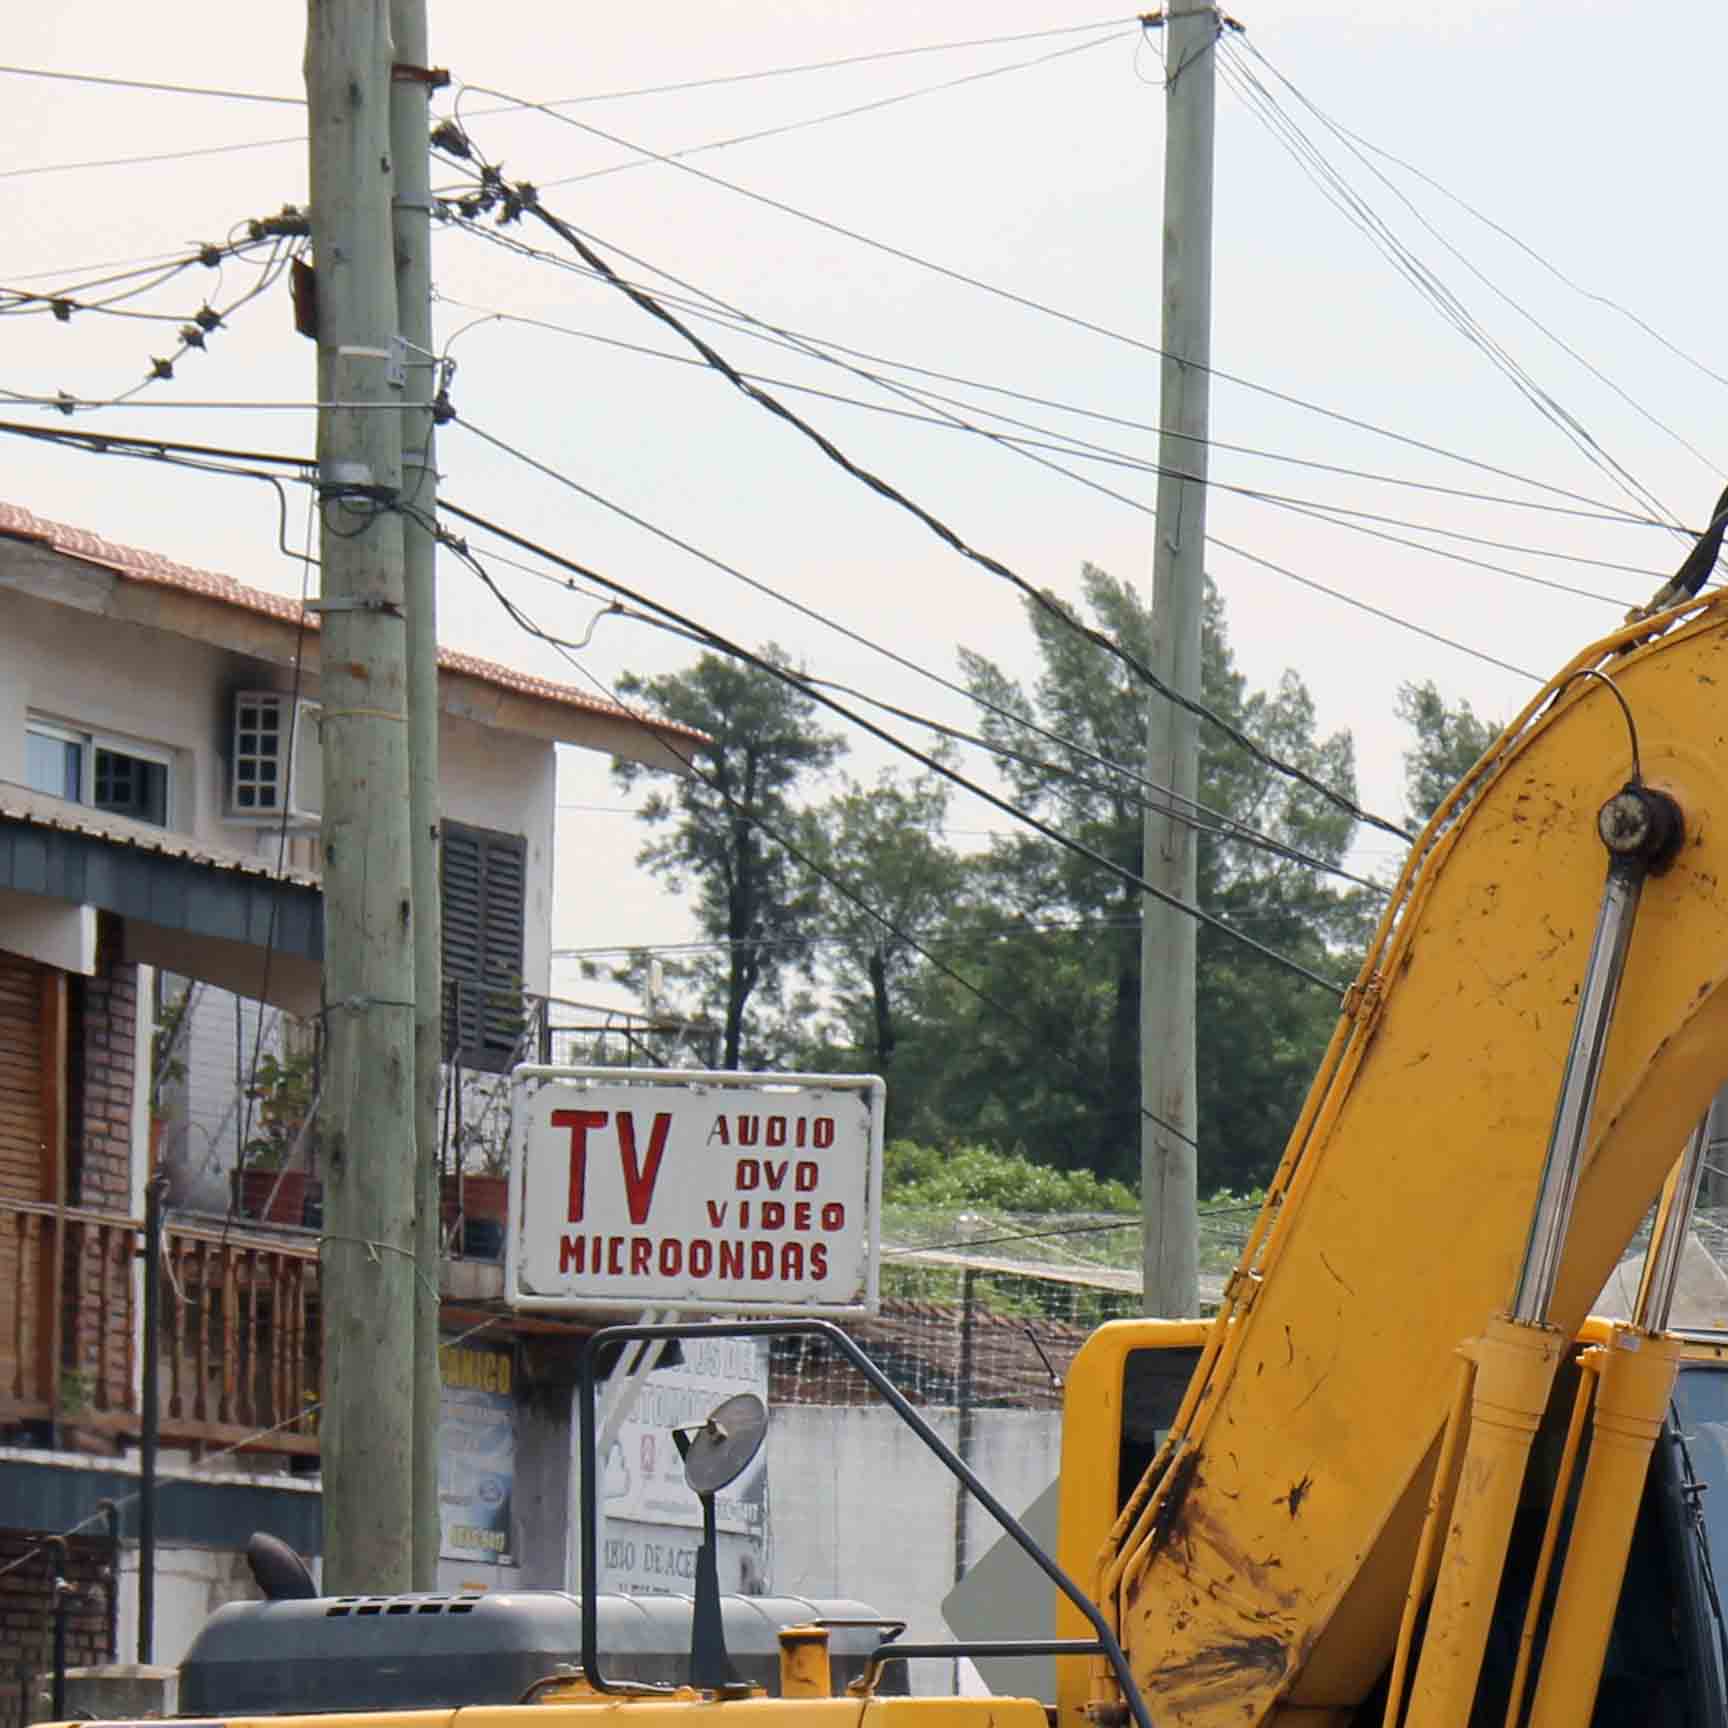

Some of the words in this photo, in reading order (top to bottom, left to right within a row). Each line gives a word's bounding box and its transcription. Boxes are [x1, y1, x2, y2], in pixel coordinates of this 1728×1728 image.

[706, 1115, 835, 1149] AUDIO
[551, 1109, 672, 1224] TV
[736, 1160, 819, 1191] DVD
[706, 1200, 845, 1232] VIDEO
[559, 1235, 829, 1281] MICROONDAS
